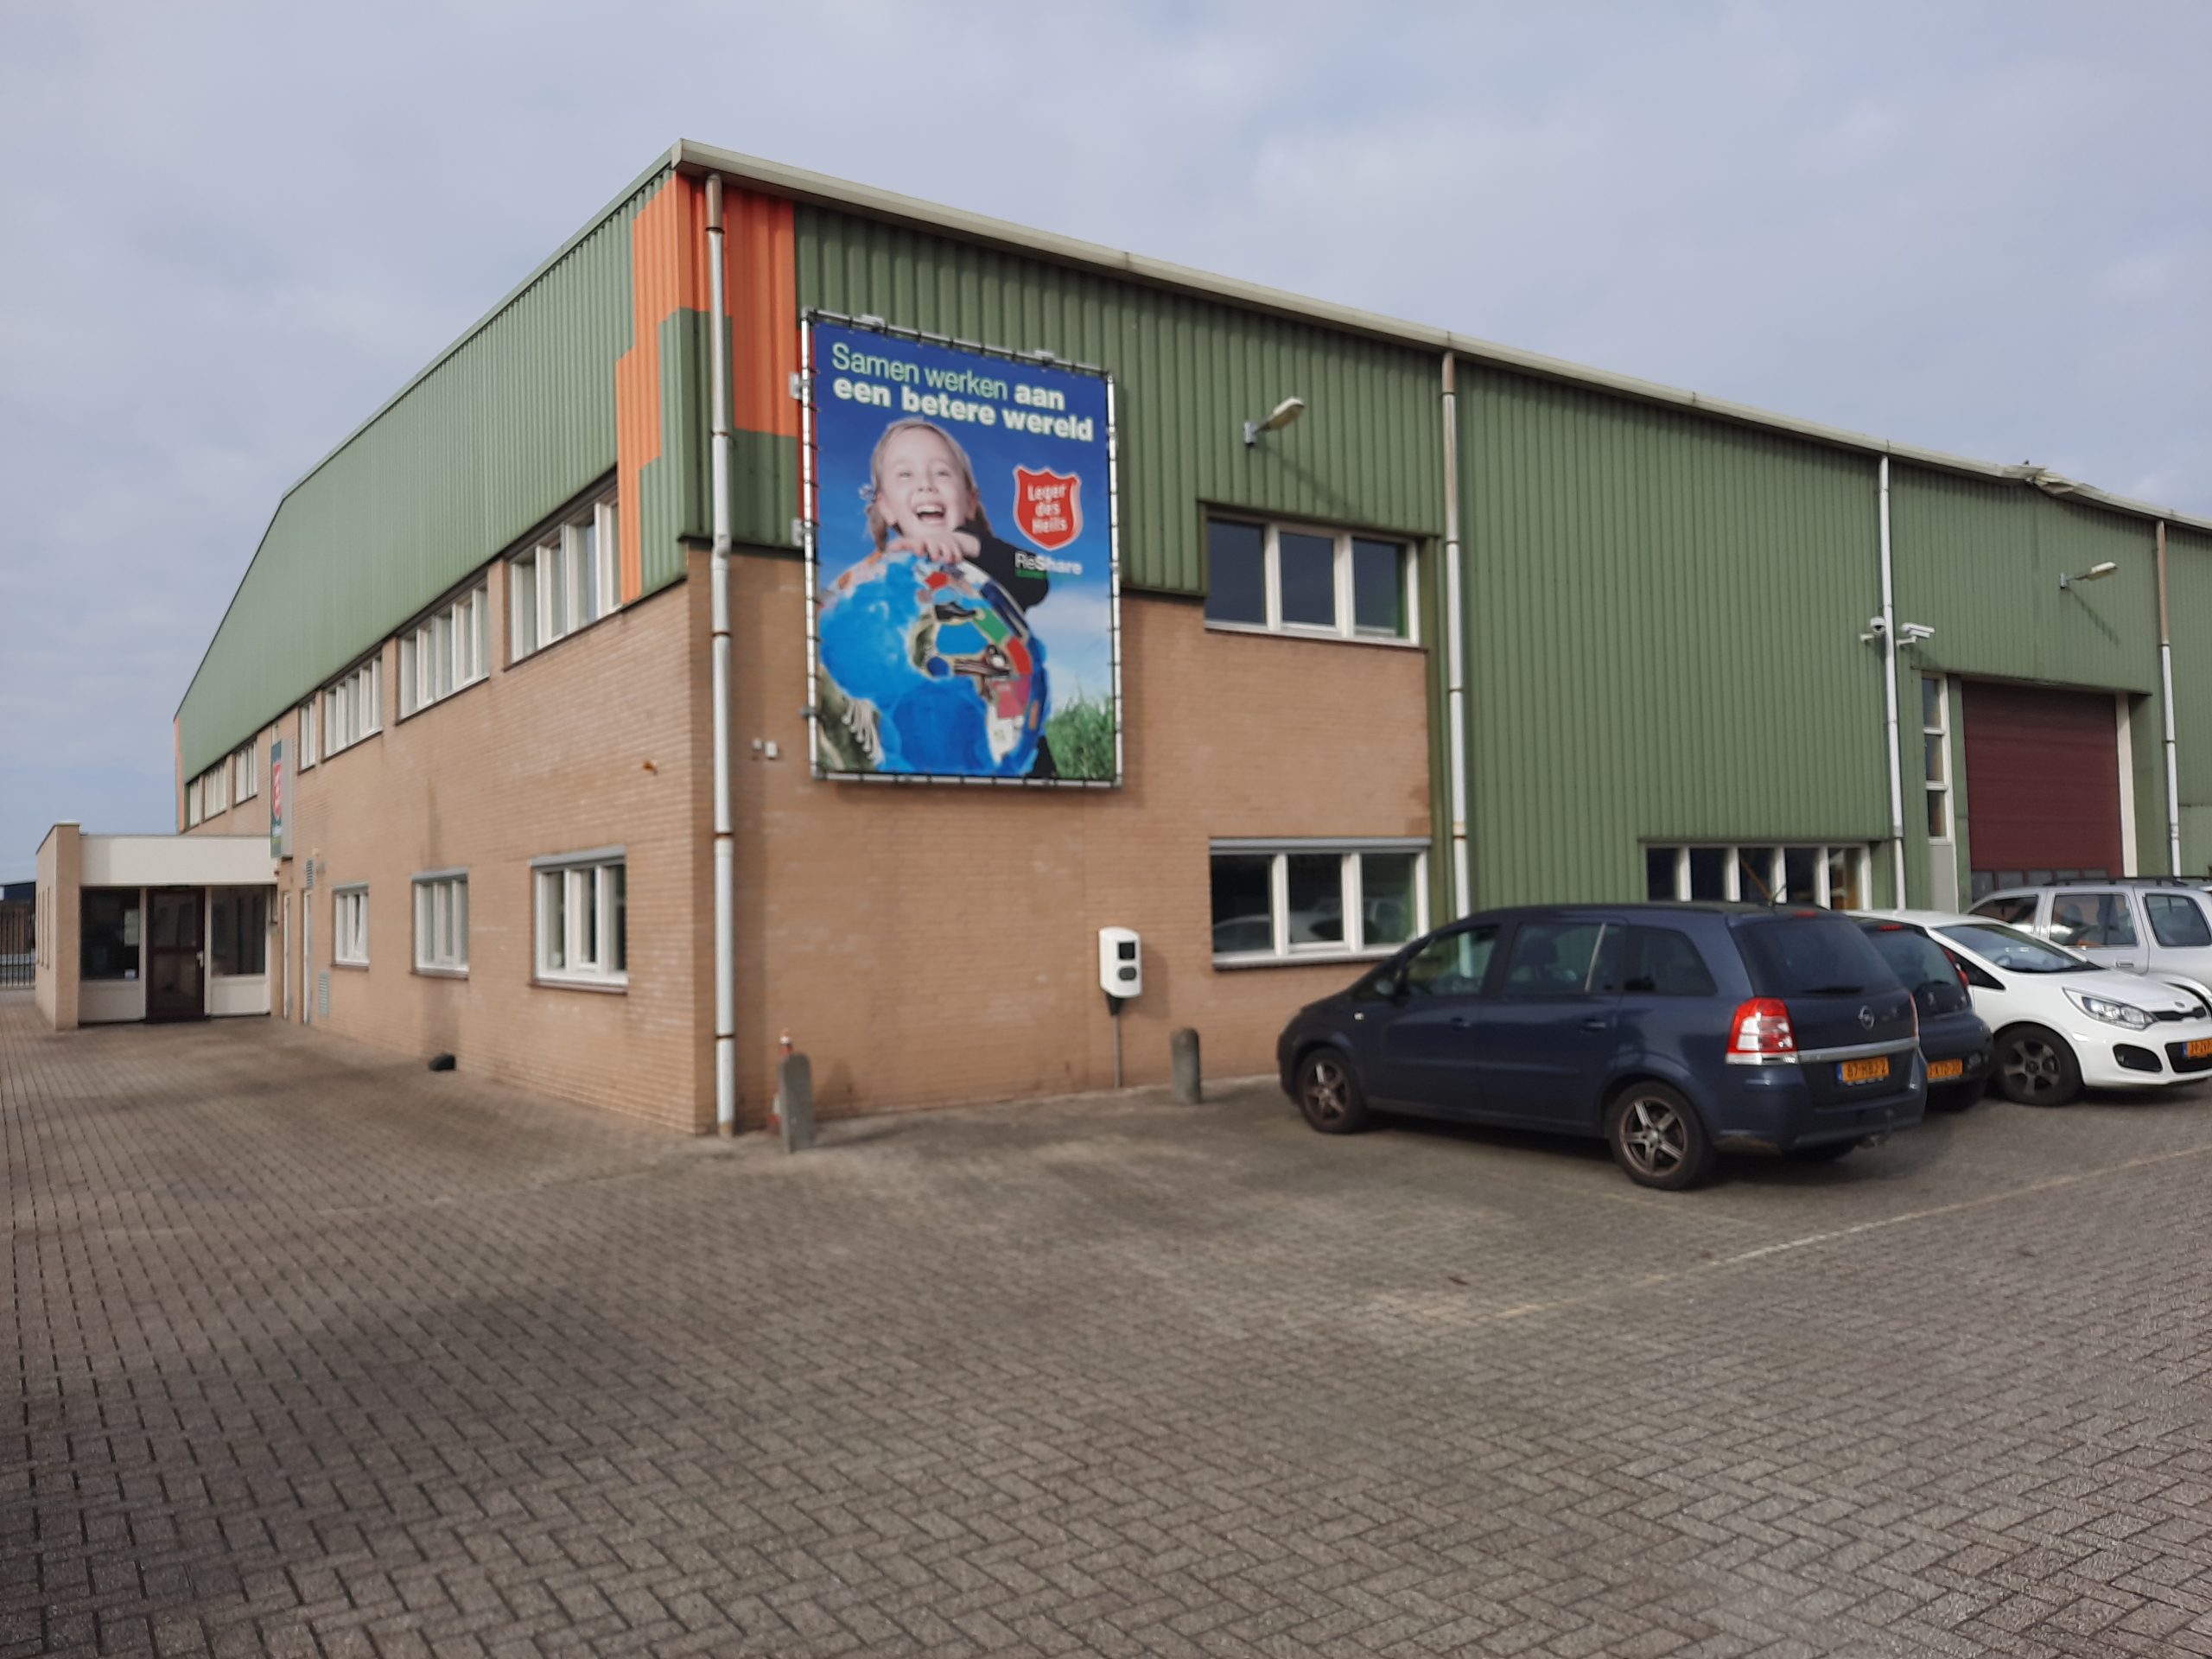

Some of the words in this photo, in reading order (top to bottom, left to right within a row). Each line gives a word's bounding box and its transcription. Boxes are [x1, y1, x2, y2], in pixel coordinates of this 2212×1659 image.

[832, 342, 919, 384] Samen
[924, 366, 1007, 400] werken
[1014, 384, 1065, 410] aan
[833, 377, 892, 407] een
[901, 386, 996, 425] betere
[1002, 407, 1094, 442] wereld
[1027, 484, 1066, 503] Leger
[1035, 501, 1061, 518] des
[1014, 551, 1083, 575] ReShare
